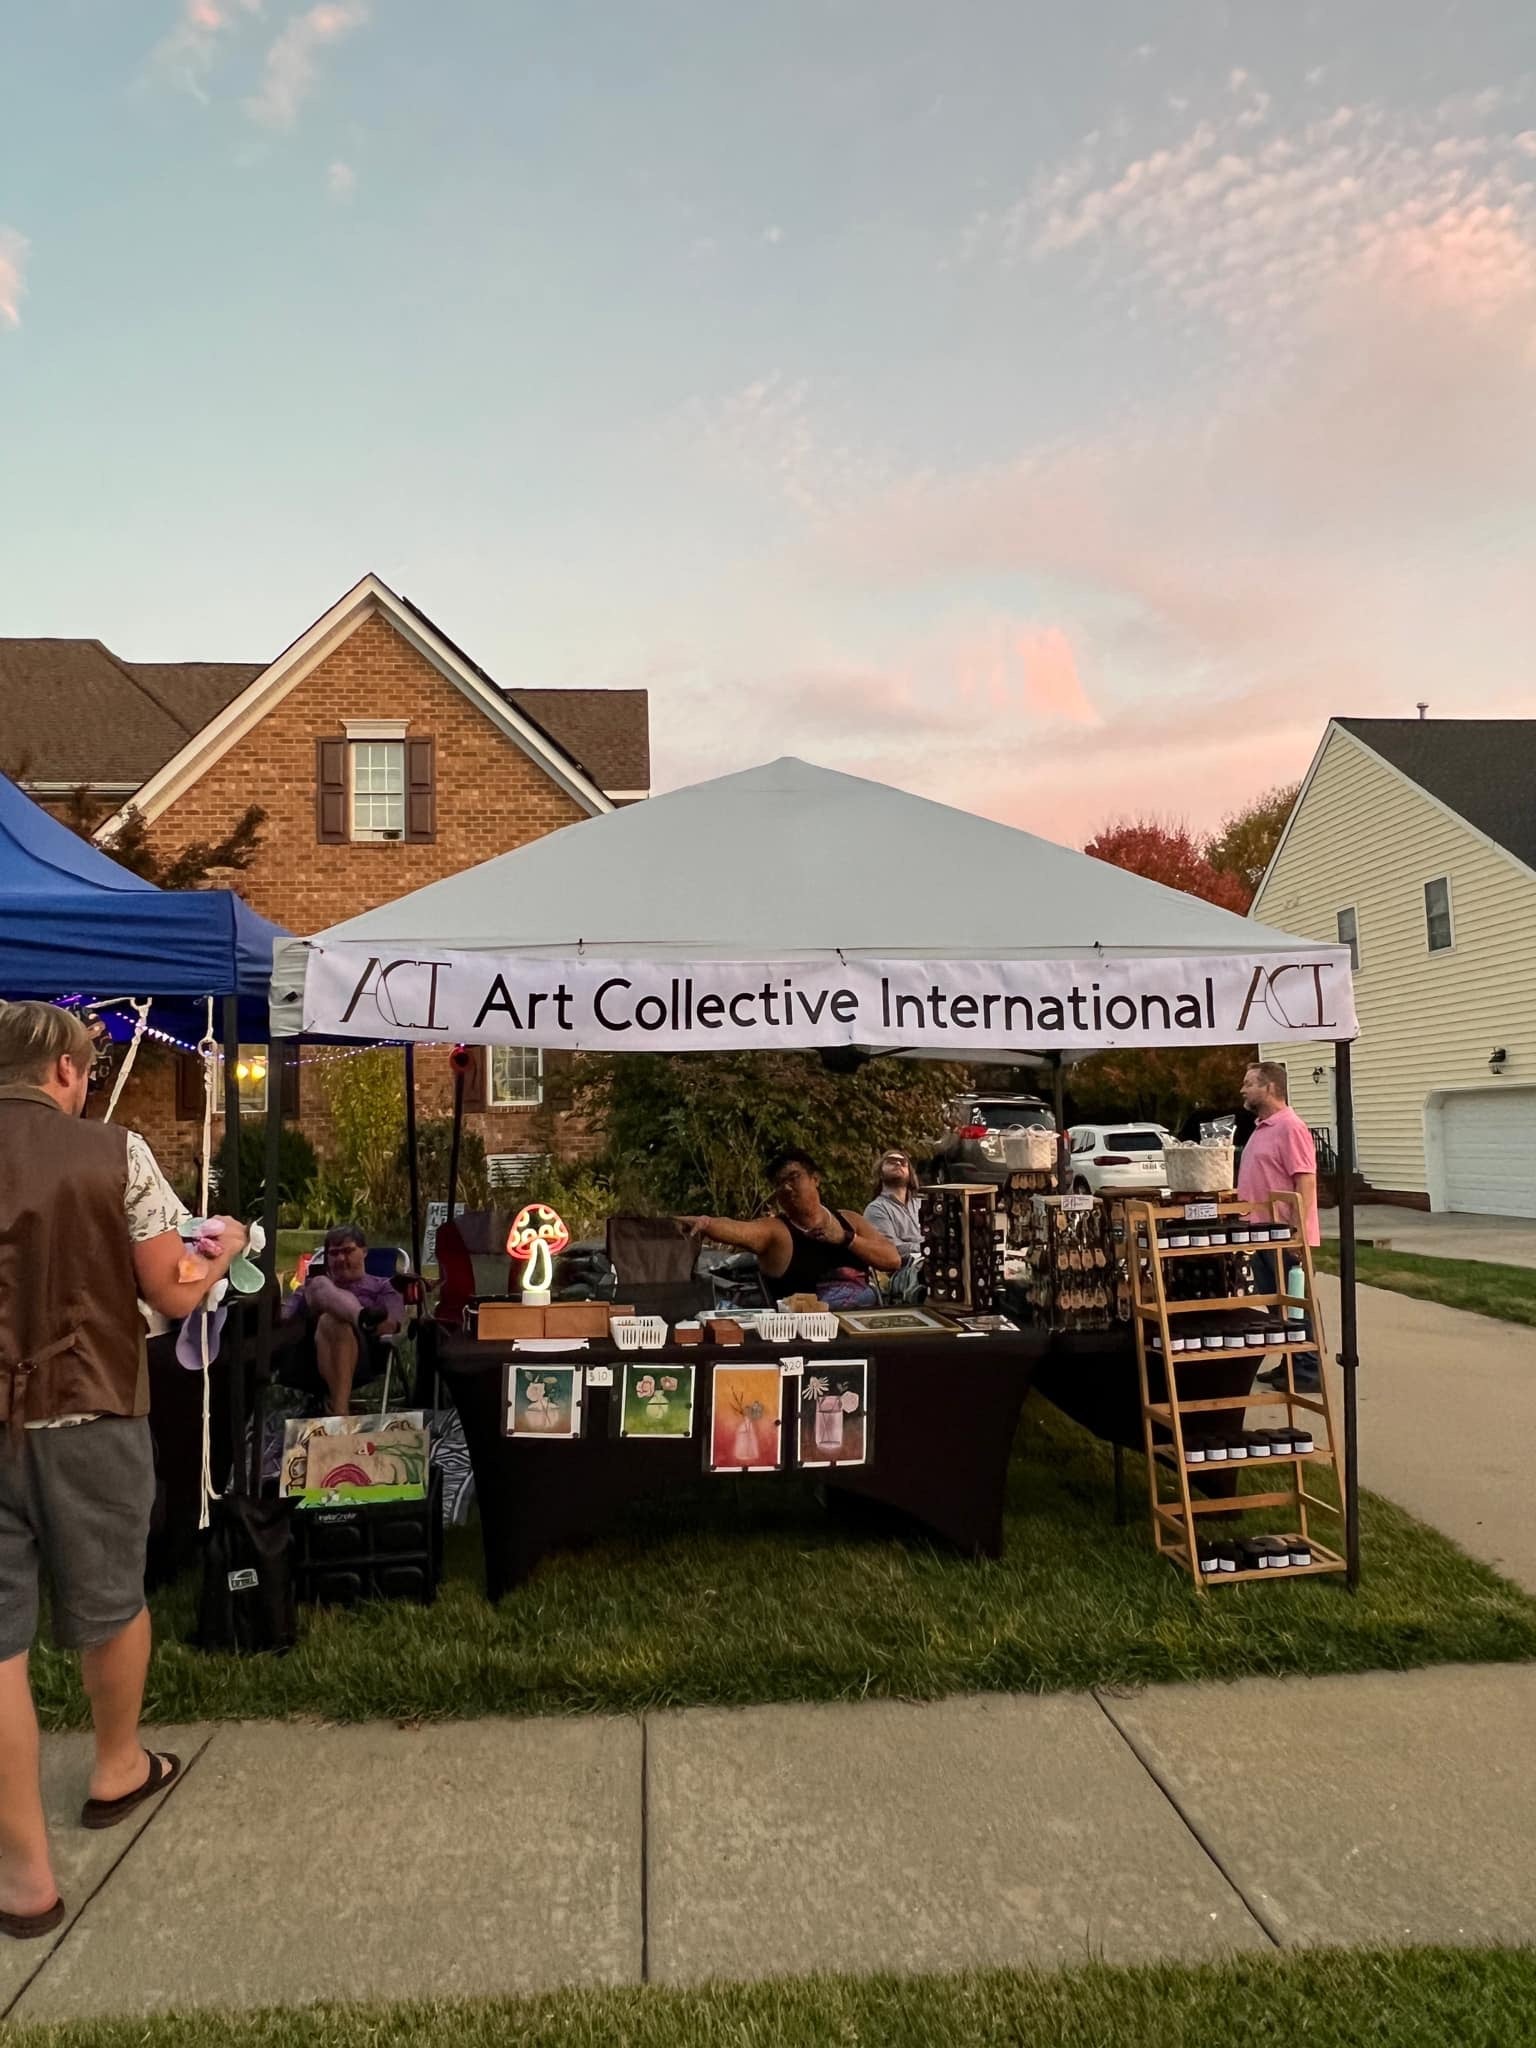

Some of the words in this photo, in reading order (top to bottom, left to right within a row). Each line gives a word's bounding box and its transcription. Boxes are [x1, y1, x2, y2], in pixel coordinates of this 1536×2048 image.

[472, 972, 574, 1030] Art
[593, 977, 859, 1031] Collective
[881, 977, 1216, 1031] International
[784, 1360, 802, 1372] $20
[589, 1371, 609, 1382] $10
